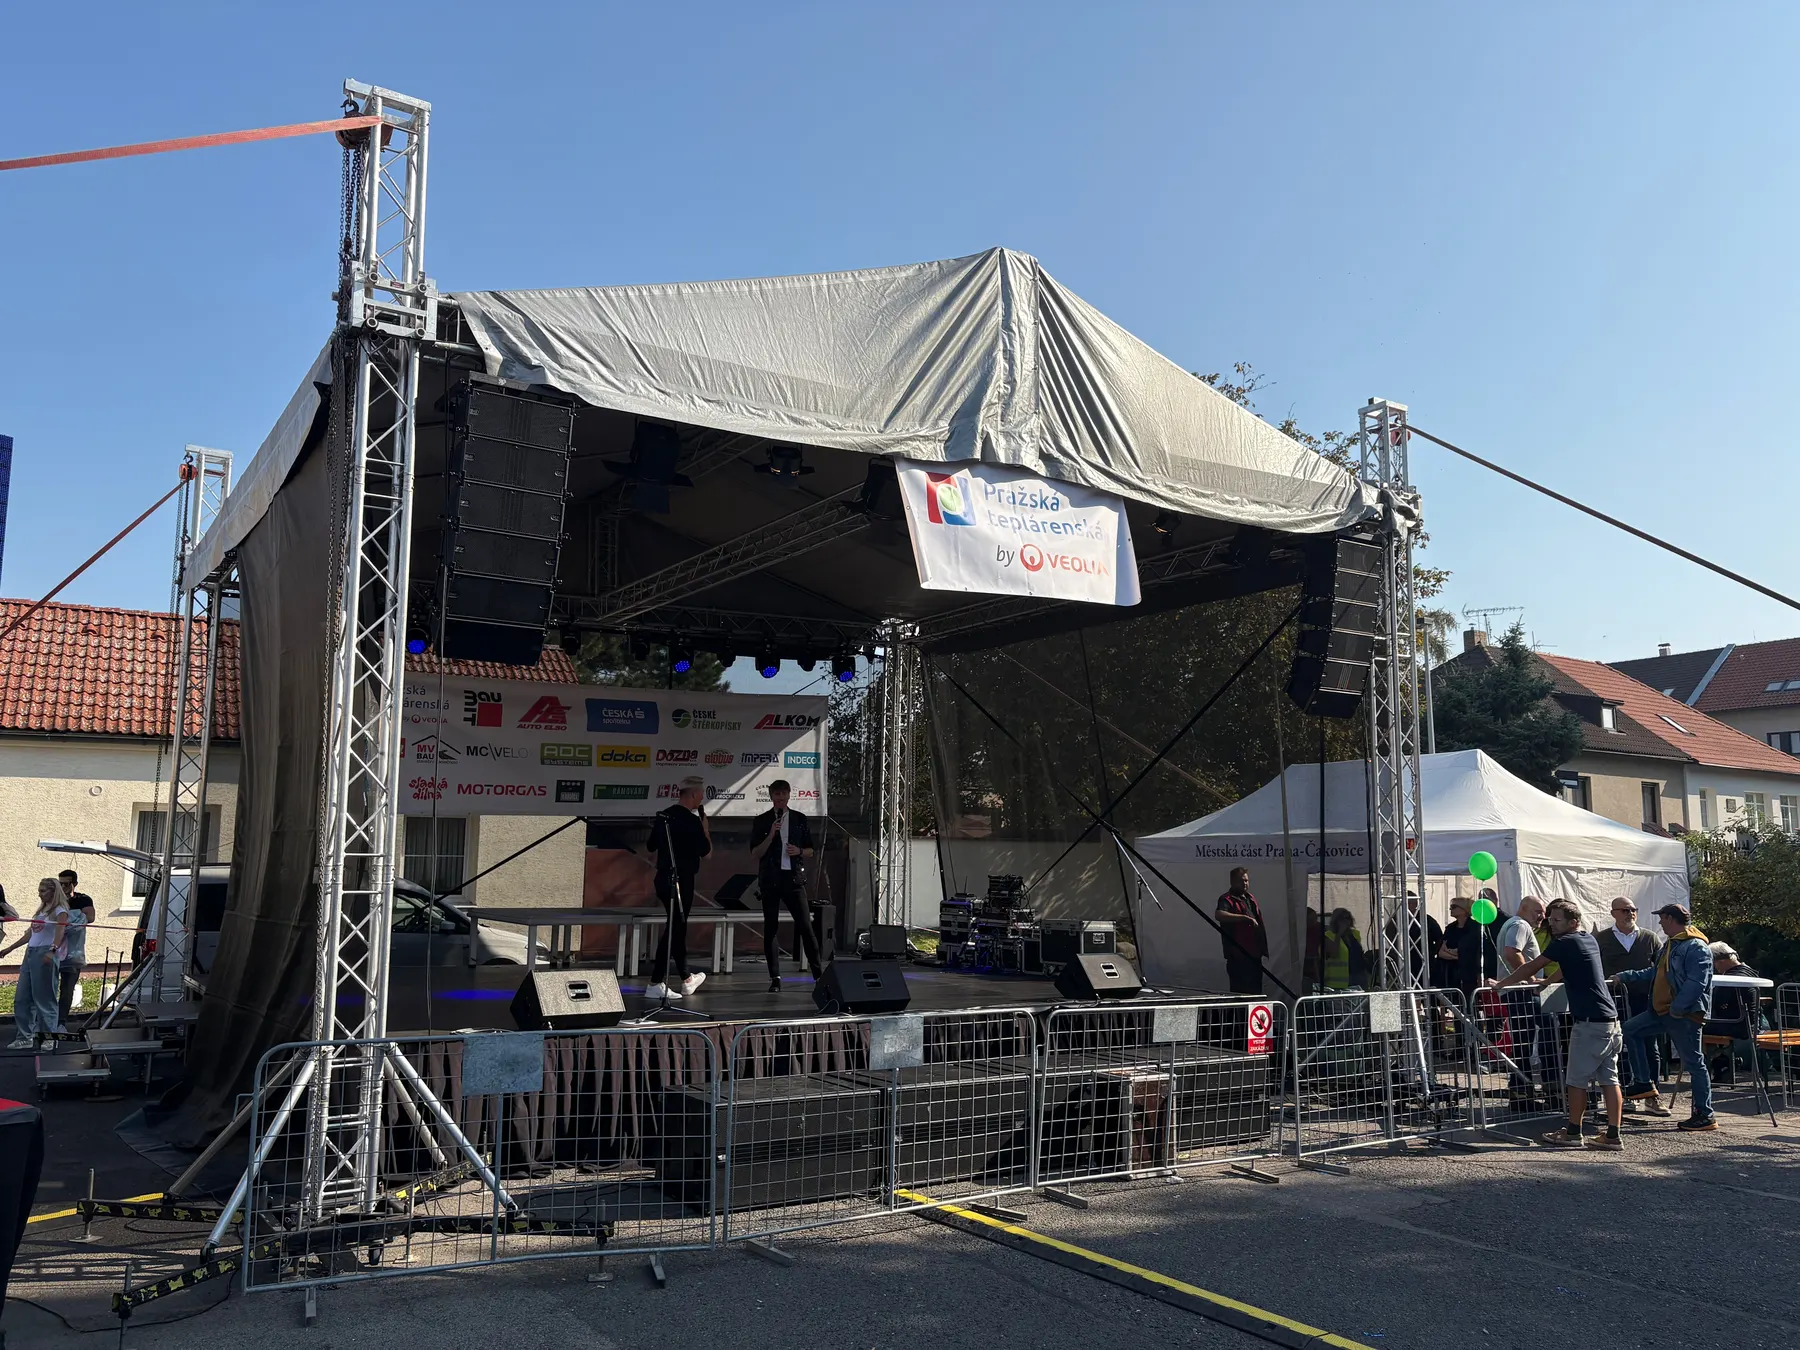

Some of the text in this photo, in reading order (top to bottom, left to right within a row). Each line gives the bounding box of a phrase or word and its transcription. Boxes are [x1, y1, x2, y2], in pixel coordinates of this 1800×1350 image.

[984, 482, 1060, 512] Pražská
[987, 509, 1104, 541] teplárenská
[996, 544, 1110, 577] by VEOLIA
[602, 707, 634, 719] ČESKÁ
[692, 708, 717, 720] ČESKÉ
[692, 719, 742, 731] ŠTĚRKOPÍSKY
[753, 713, 821, 730] ALKOM
[417, 744, 436, 753] MV
[416, 752, 435, 760] BAU
[601, 749, 647, 763] doka
[787, 755, 817, 765] INDECO
[457, 783, 547, 797] MOTORGAS
[798, 790, 820, 798] PAS
[1195, 843, 1238, 858] Městská
[1241, 842, 1262, 858] část
